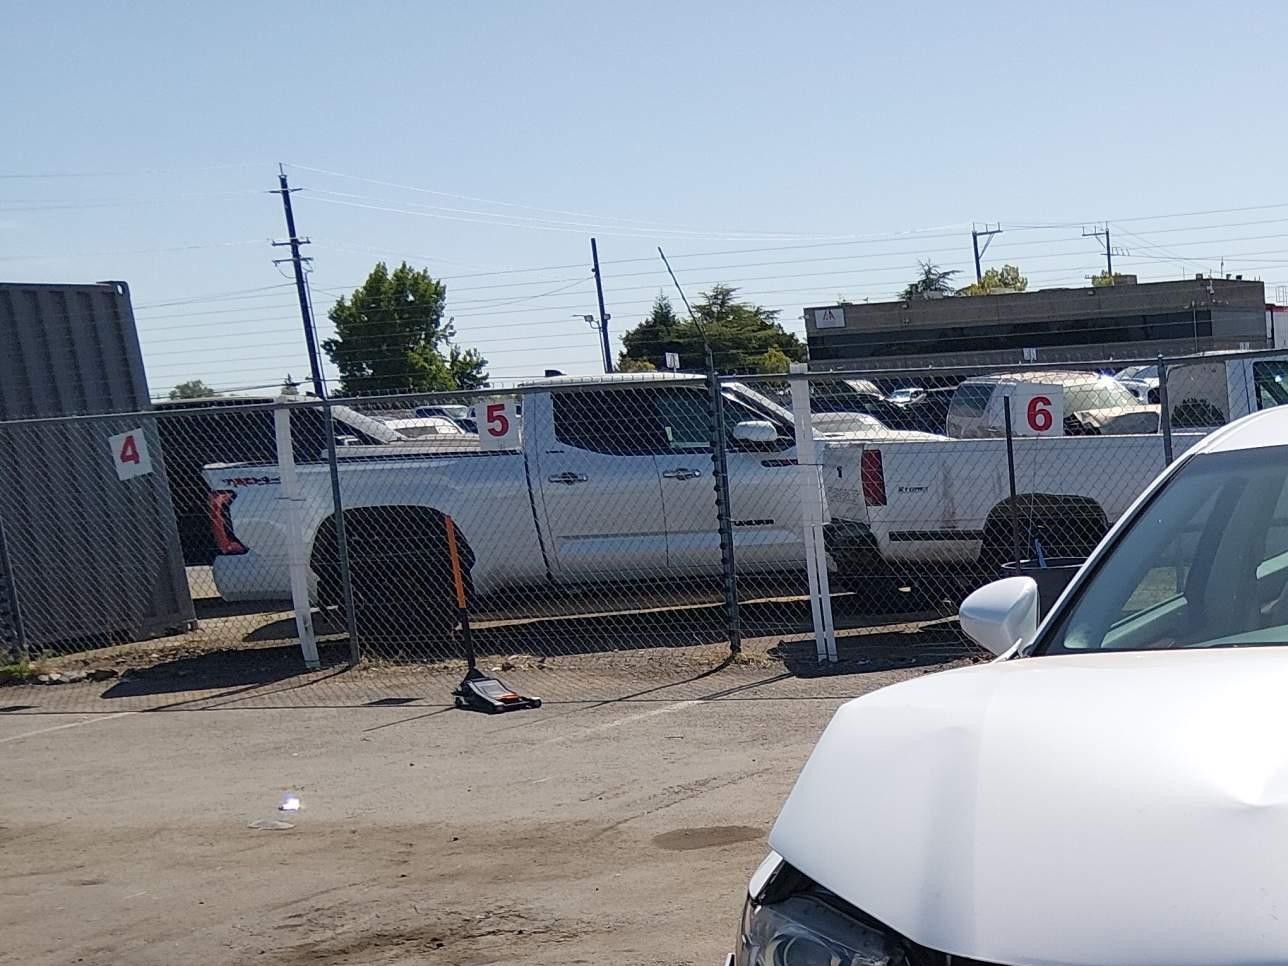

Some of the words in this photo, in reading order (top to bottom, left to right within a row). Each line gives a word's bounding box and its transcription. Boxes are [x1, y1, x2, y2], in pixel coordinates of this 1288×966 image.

[486, 403, 509, 437] 5
[1027, 396, 1053, 432] 6
[120, 435, 140, 465] 4
